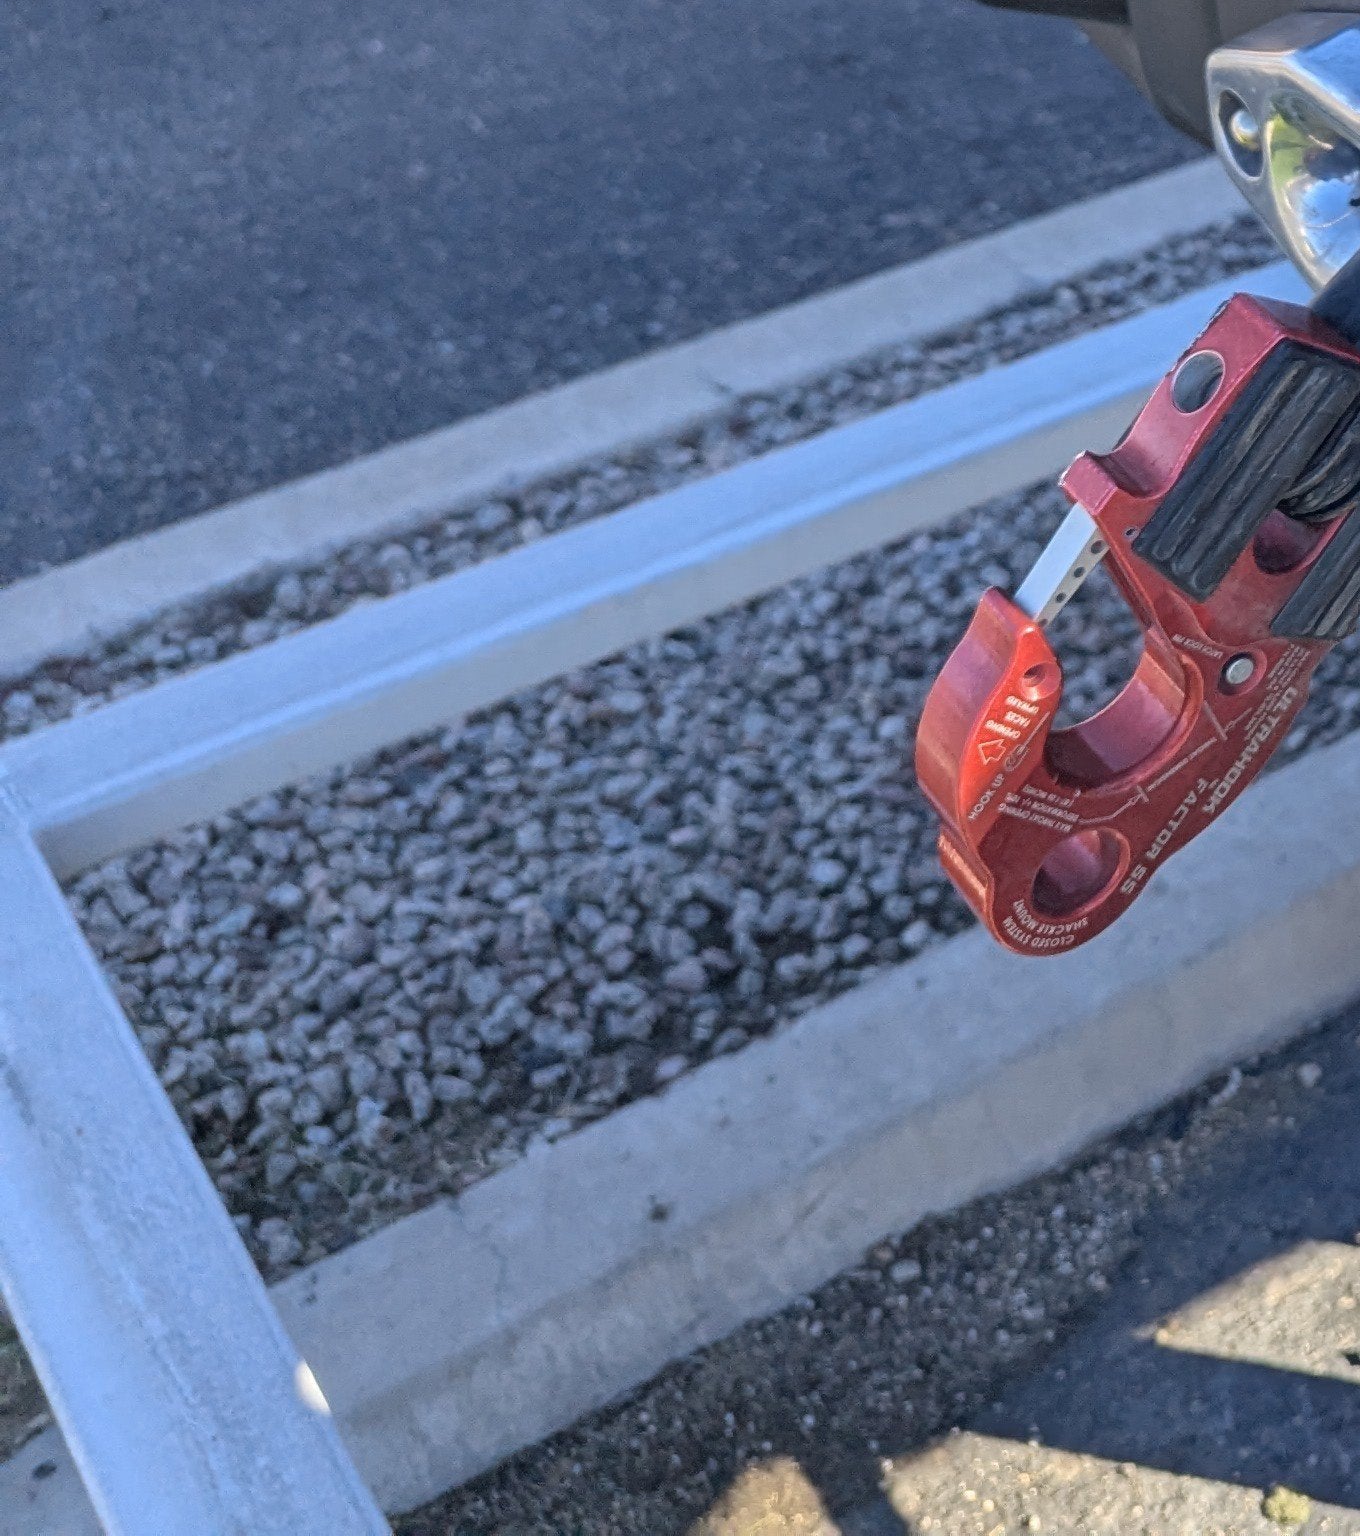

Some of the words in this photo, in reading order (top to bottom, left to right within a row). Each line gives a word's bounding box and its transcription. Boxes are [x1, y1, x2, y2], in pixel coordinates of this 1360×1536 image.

[1202, 686, 1298, 814] ULTRAHOOK
[968, 789, 997, 821] HOOK
[991, 773, 1005, 789] UP
[1146, 777, 1209, 860] FACTOR
[1002, 915, 1032, 945] SYSTEM
[1012, 899, 1039, 931] MOUNT
[1037, 916, 1089, 935] SHACKLE
[1031, 934, 1075, 948] CLOSED
